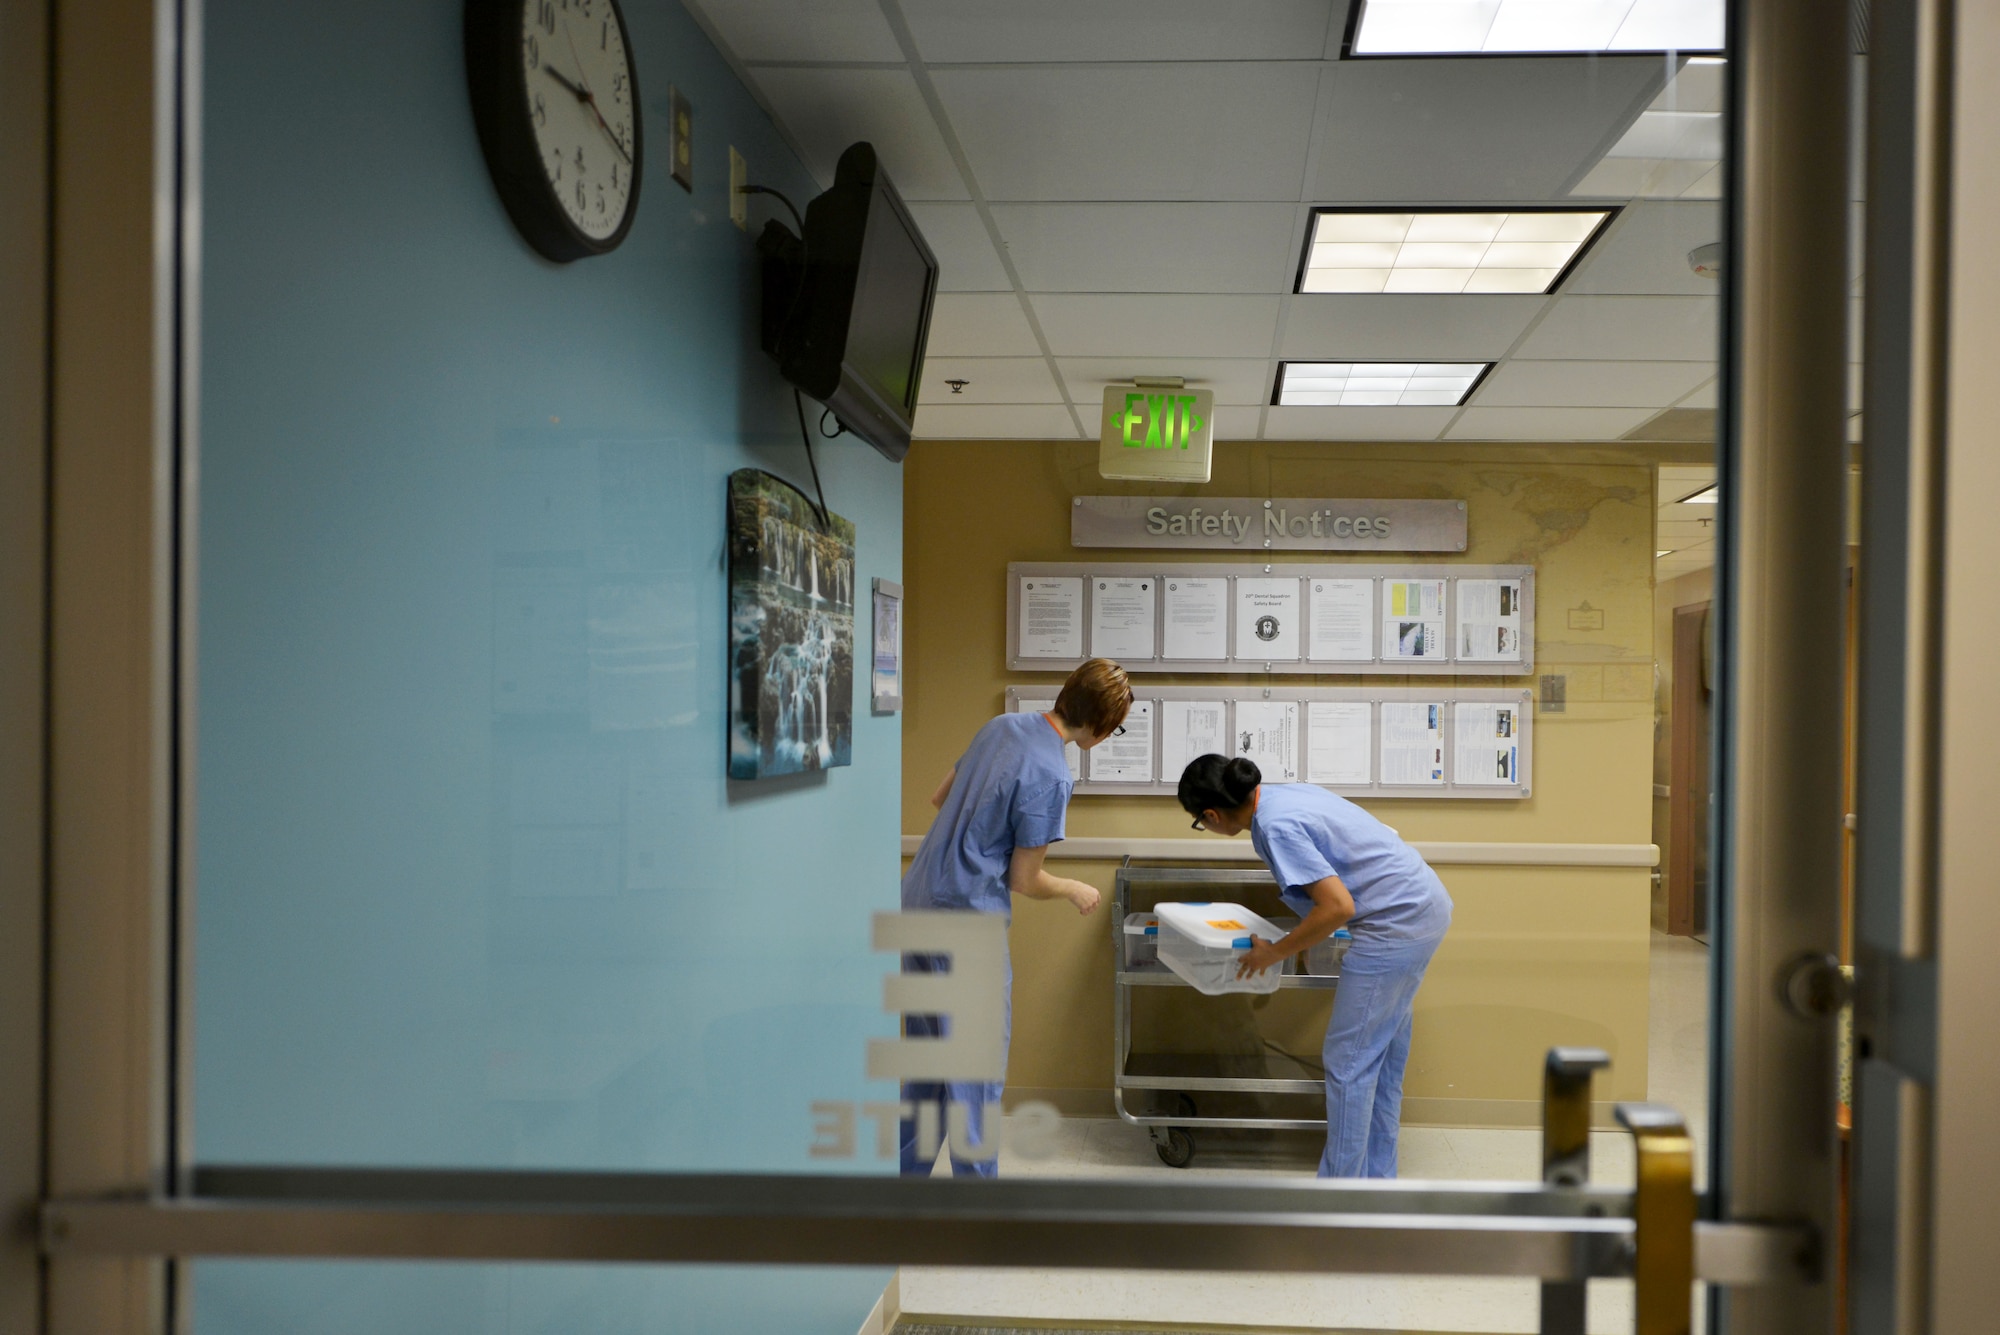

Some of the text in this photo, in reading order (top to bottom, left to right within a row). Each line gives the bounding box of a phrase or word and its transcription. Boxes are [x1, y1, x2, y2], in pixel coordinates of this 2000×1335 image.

[529, 34, 539, 69] 9
[576, 179, 587, 211] 6
[1123, 393, 1197, 450] EXIT
[1146, 507, 1392, 543] Safety Notices
